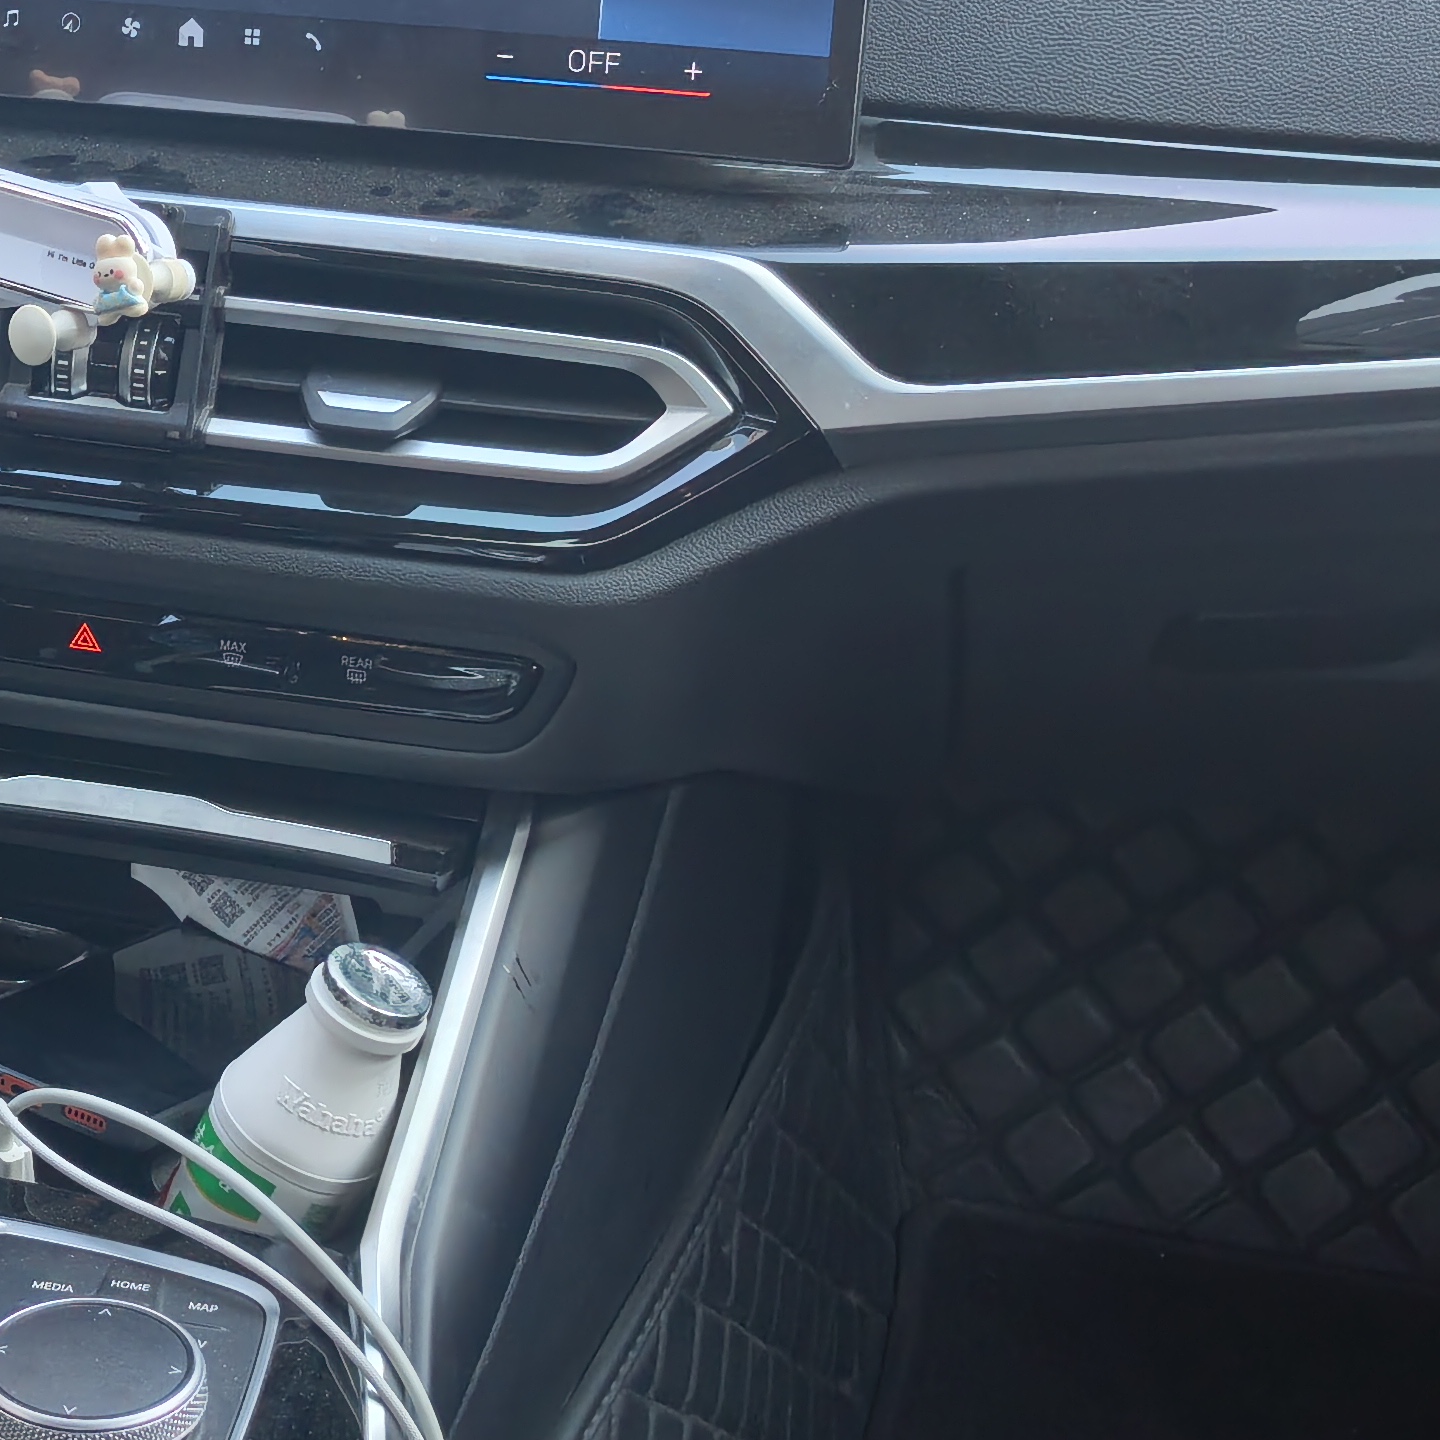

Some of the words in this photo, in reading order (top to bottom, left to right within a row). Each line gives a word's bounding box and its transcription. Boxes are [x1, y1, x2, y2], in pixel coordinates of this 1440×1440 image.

[568, 49, 622, 75] OFF
[219, 639, 247, 654] MAX
[340, 655, 373, 671] REAR
[31, 1279, 74, 1294] MEDIA
[109, 1278, 151, 1293] HOME
[187, 1301, 219, 1314] MAP
